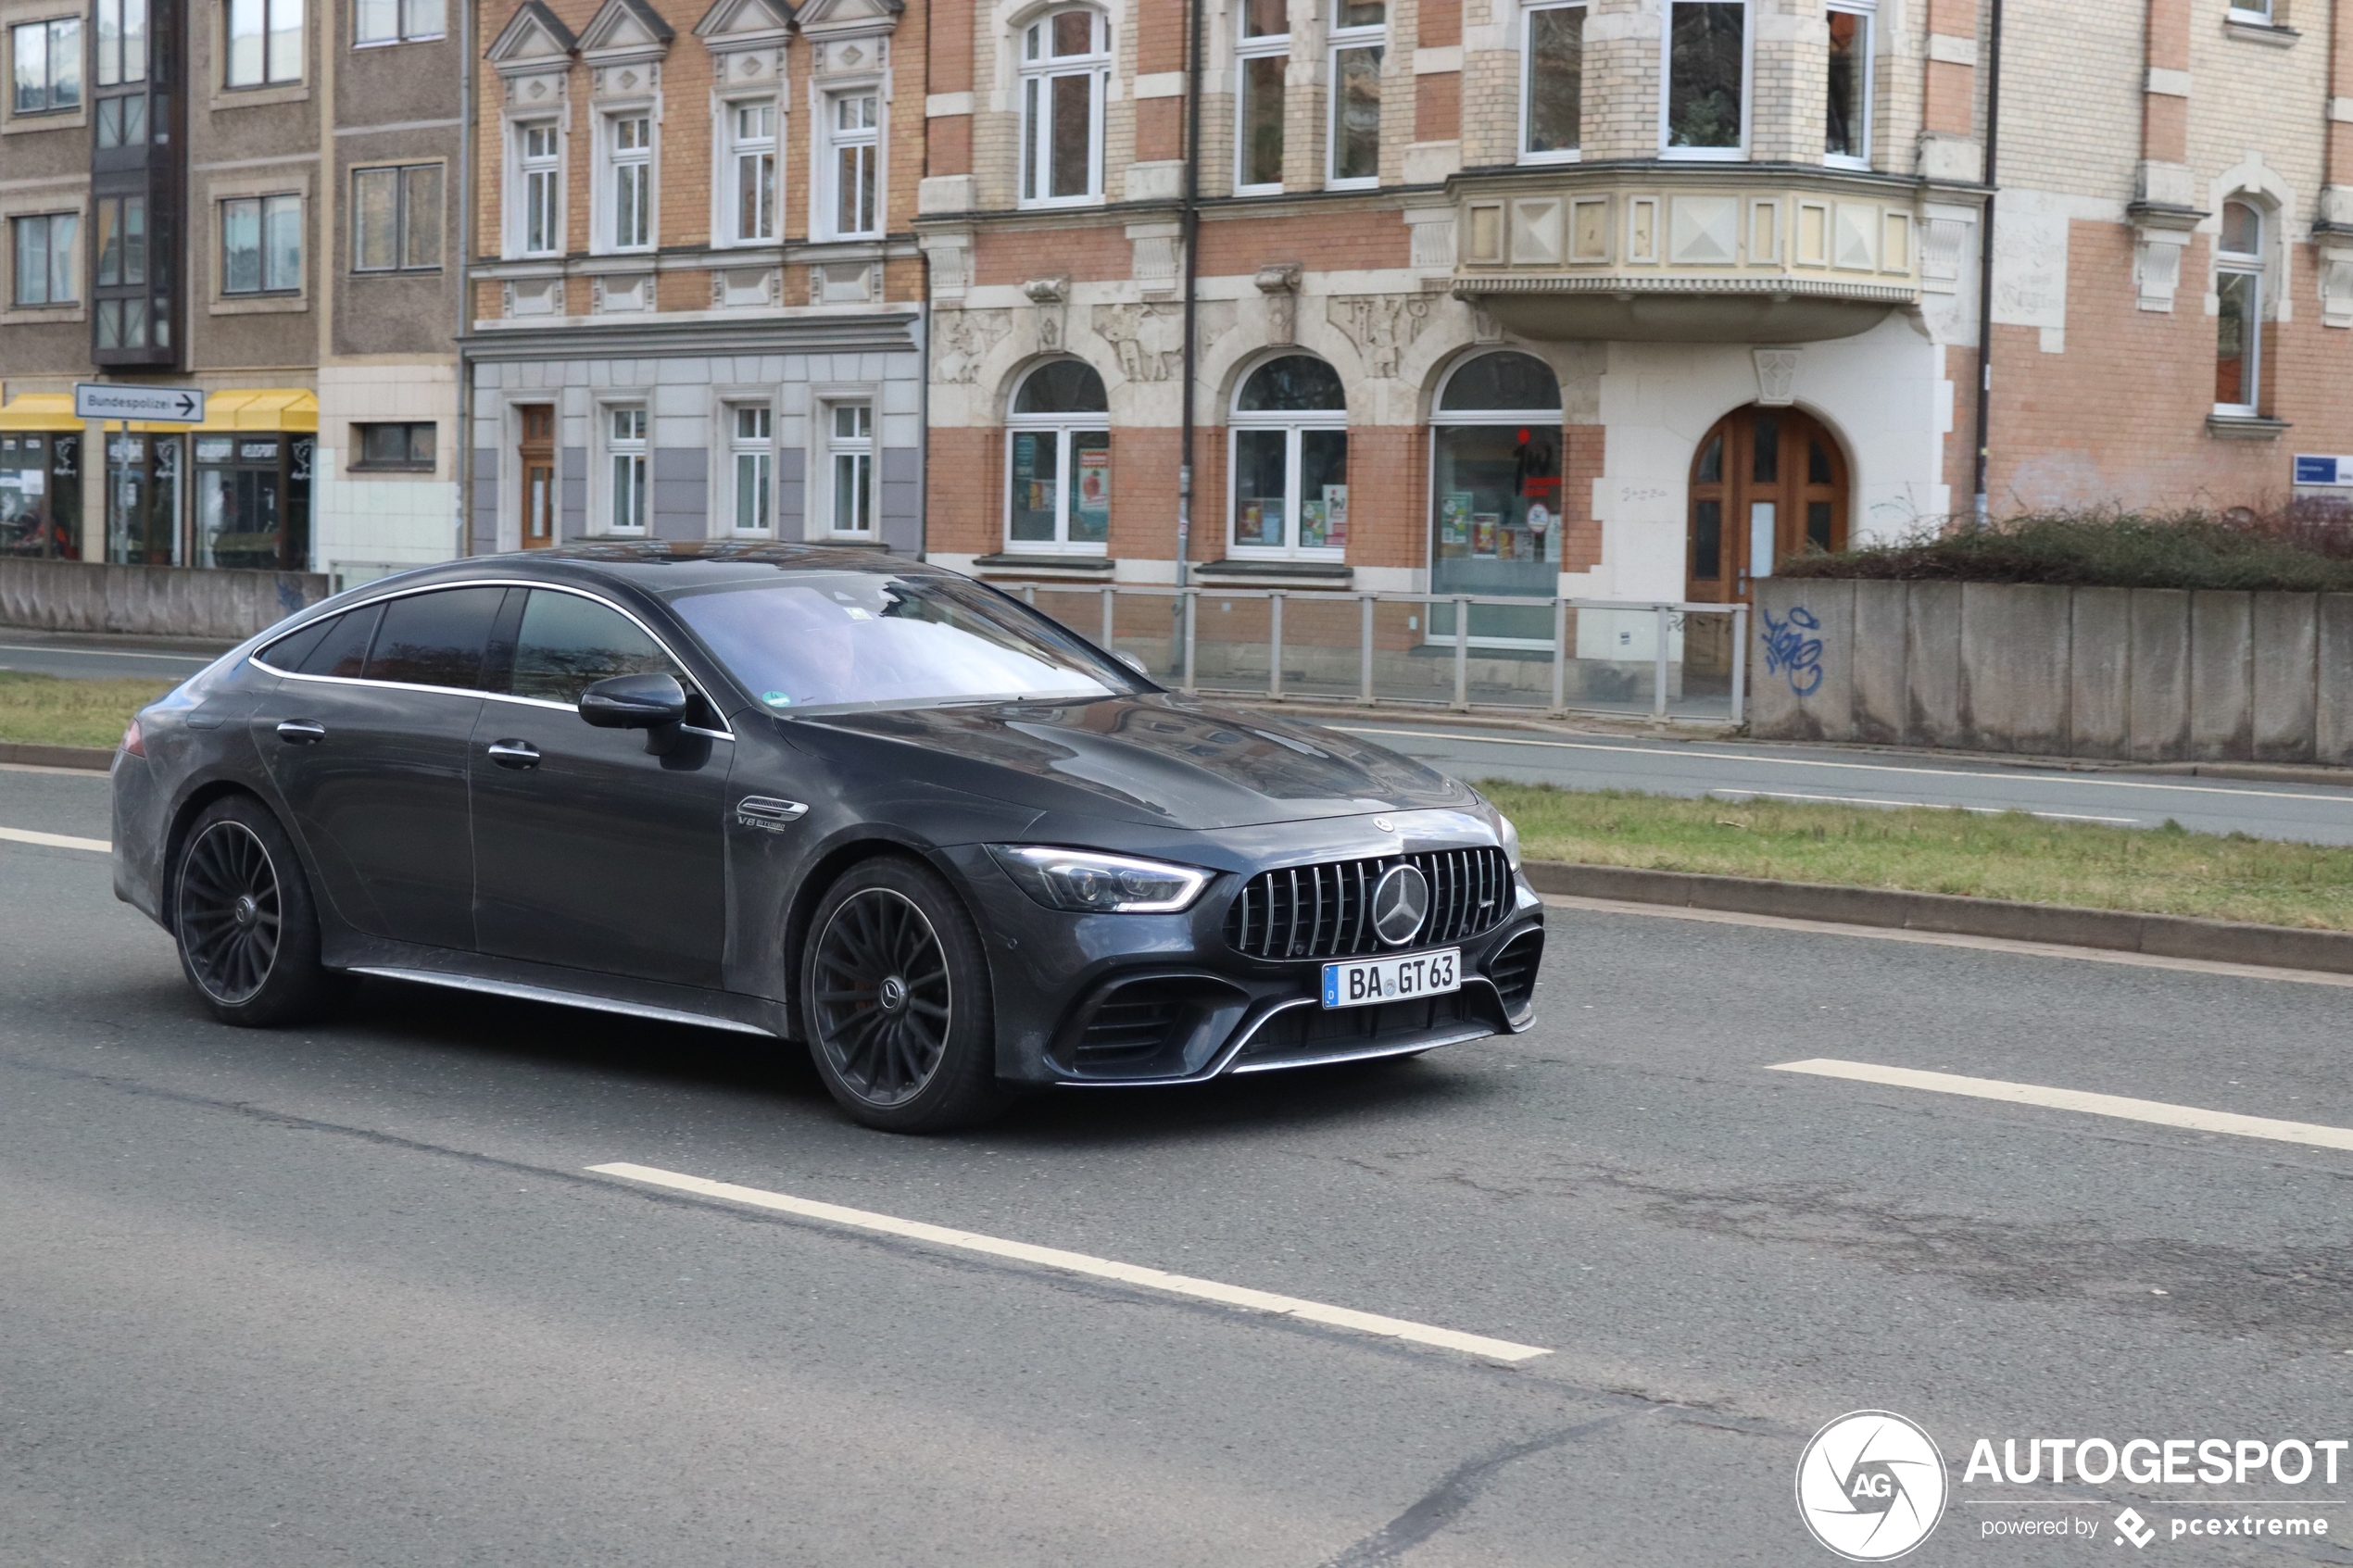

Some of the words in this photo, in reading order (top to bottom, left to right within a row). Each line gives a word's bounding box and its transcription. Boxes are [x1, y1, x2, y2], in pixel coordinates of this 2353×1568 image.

[87, 395, 171, 409] Bundespolizei
[737, 816, 756, 826] V8
[756, 820, 786, 830] BITURBO
[1350, 966, 1382, 1000] BA
[1399, 960, 1426, 994] GT
[1429, 955, 1453, 988] 63
[1328, 990, 1335, 1000] D
